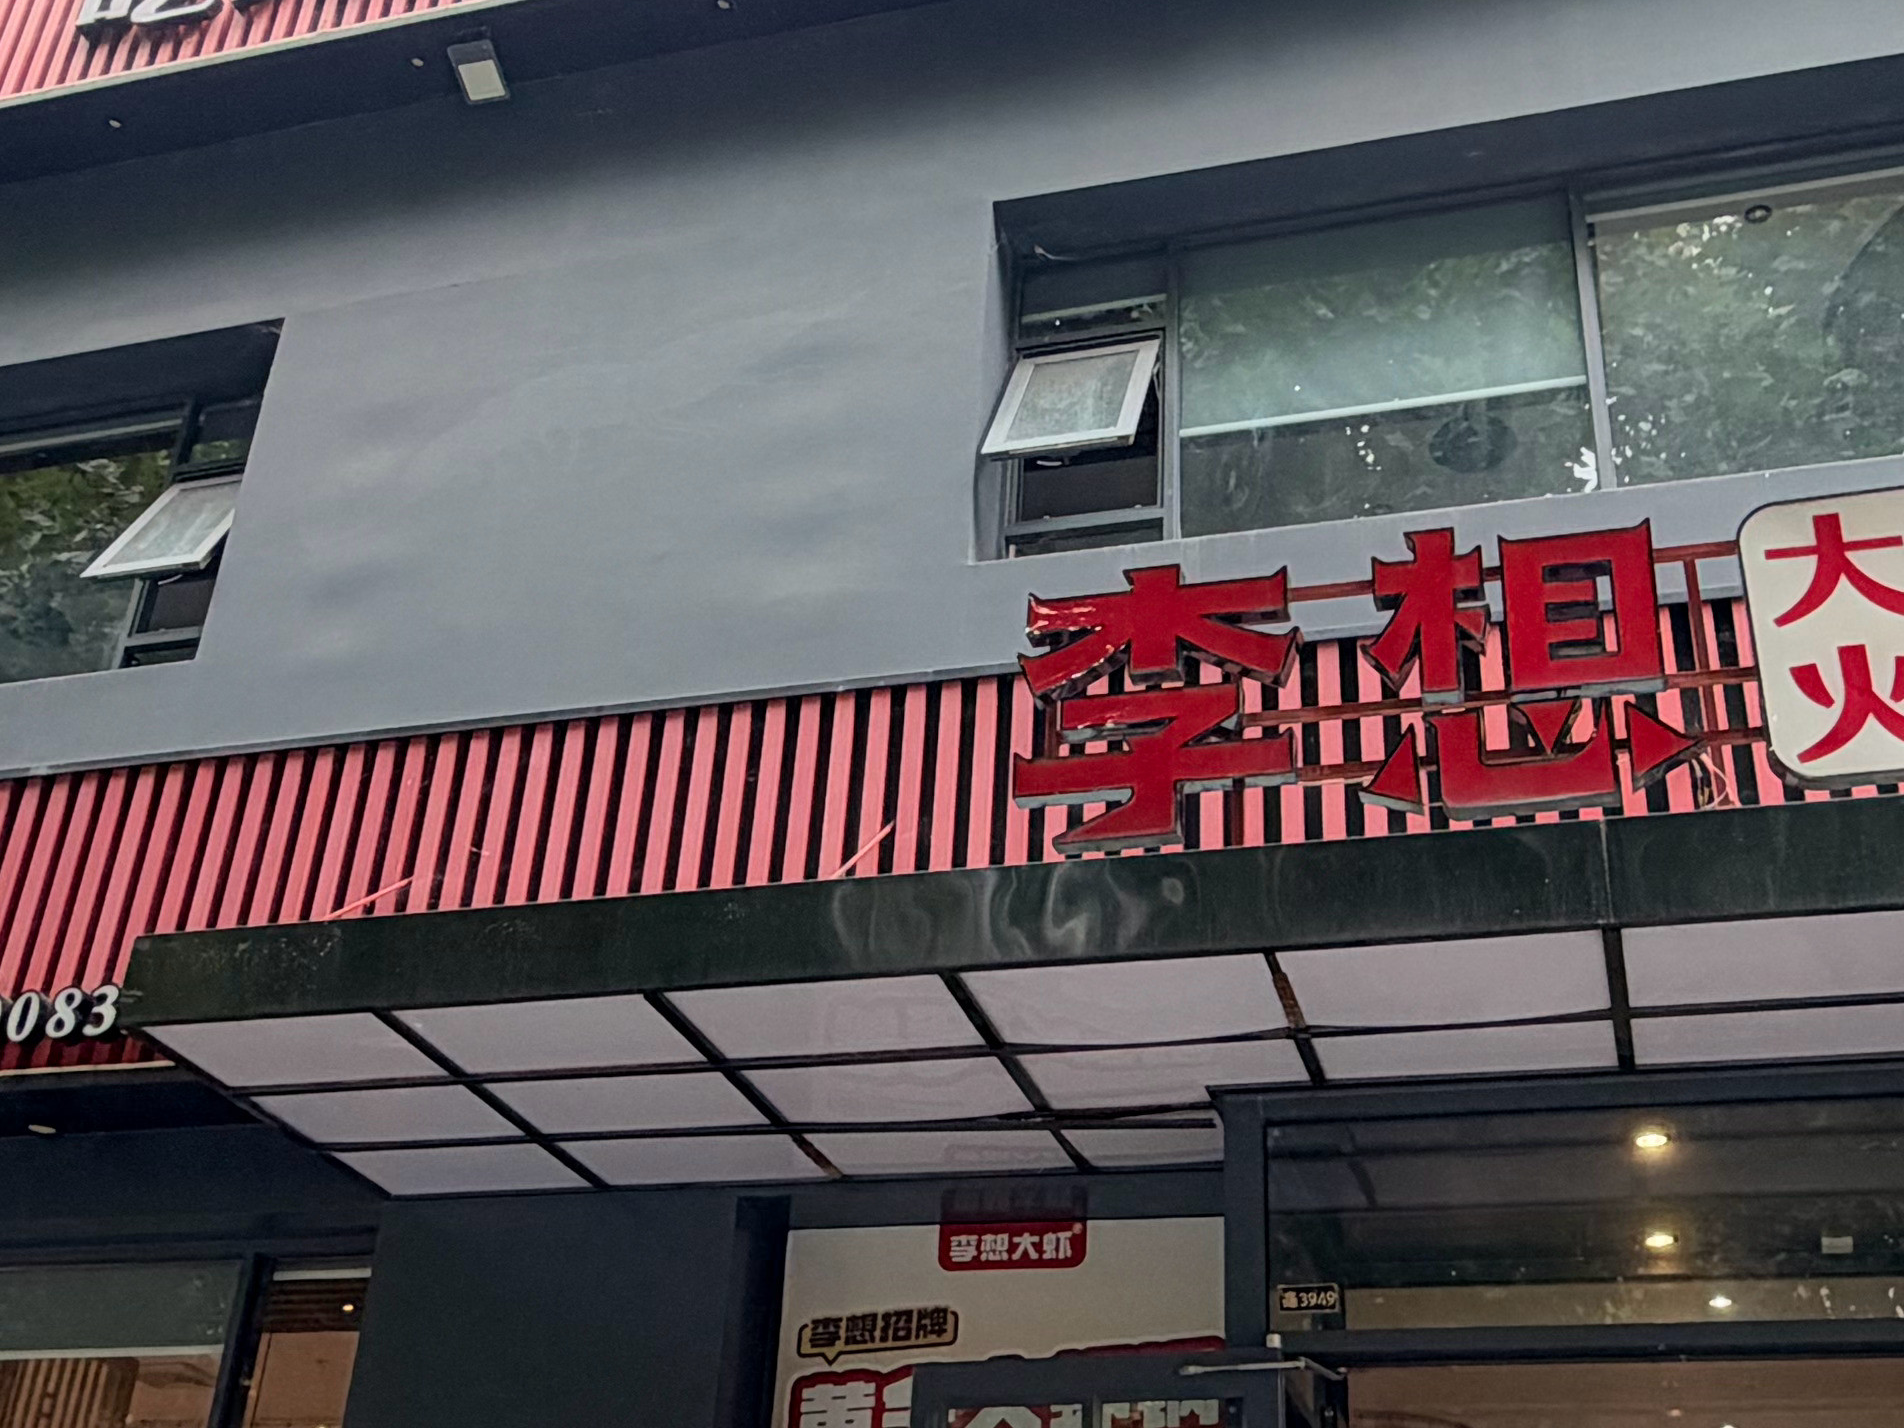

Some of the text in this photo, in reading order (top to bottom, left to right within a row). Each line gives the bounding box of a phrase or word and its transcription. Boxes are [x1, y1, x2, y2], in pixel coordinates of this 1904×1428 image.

[1012, 517, 1702, 852] 李想
[948, 1230, 1074, 1264] 李想大虾
[808, 1306, 950, 1350] 李想招牌
